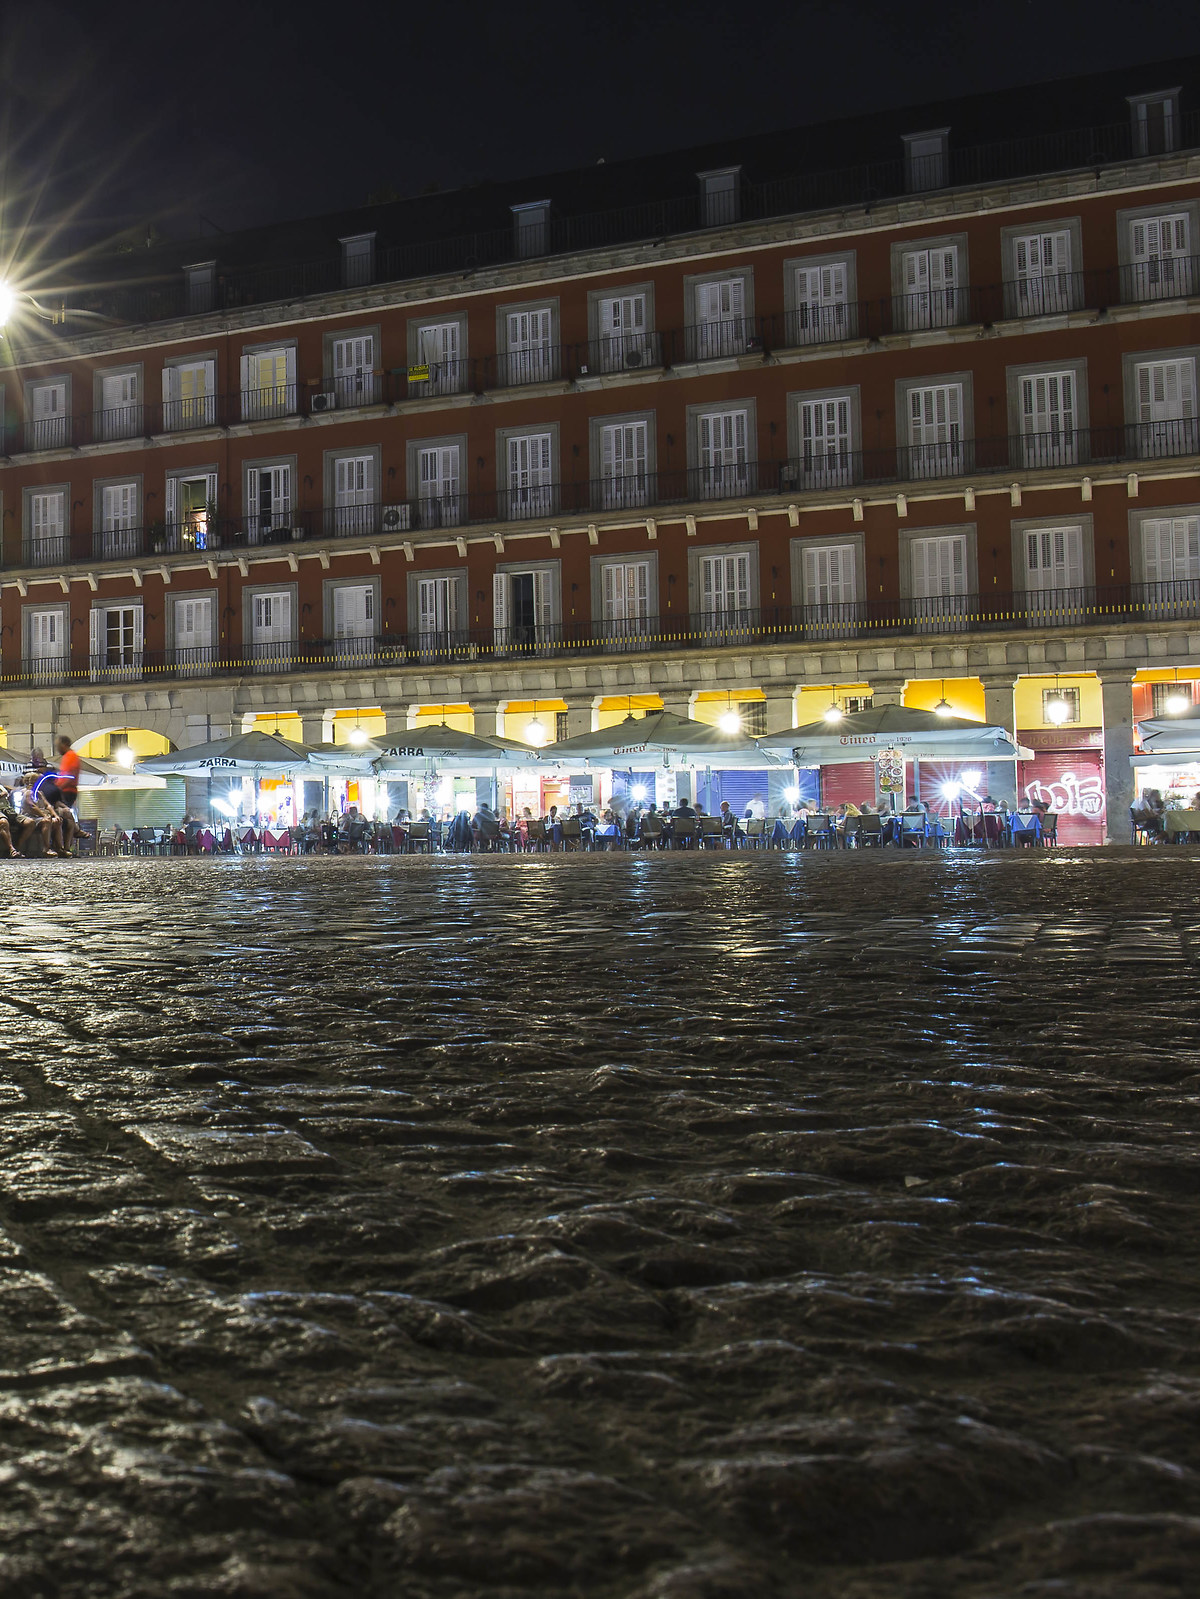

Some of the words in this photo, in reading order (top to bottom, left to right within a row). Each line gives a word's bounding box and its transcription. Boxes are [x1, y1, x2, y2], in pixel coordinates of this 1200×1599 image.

[1029, 733, 1085, 746] JUGUETES
[381, 746, 425, 757] ZARRA
[199, 757, 238, 768] ZARRA
